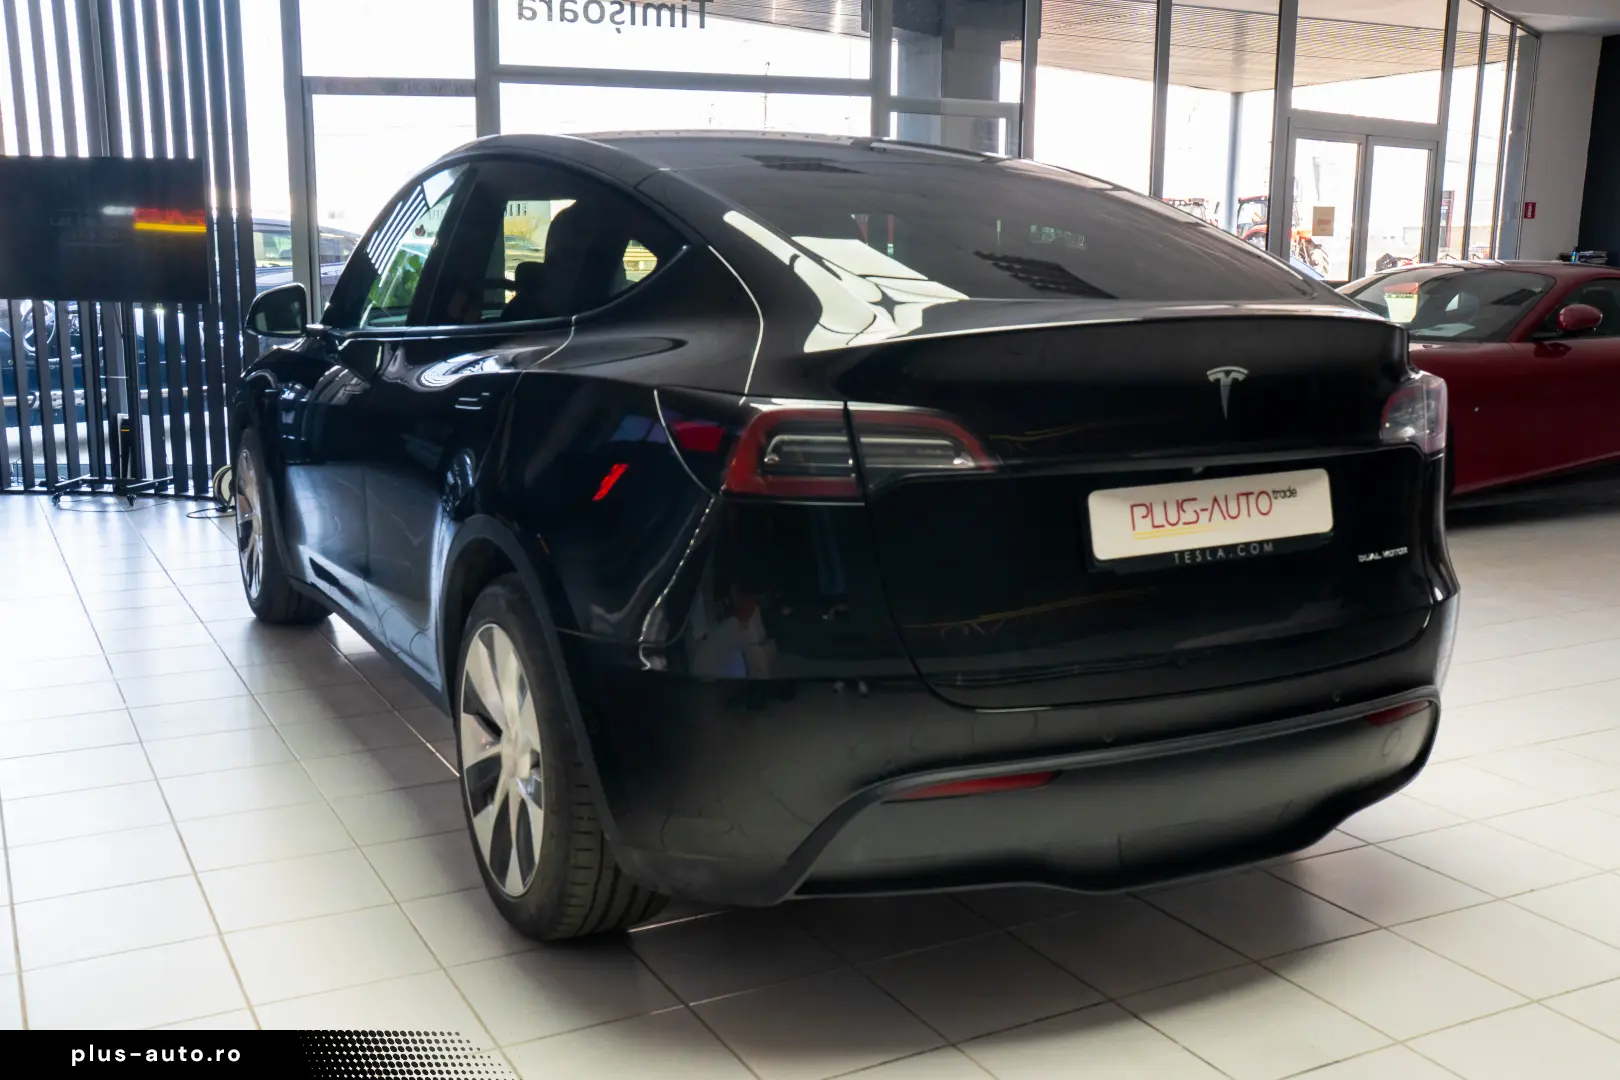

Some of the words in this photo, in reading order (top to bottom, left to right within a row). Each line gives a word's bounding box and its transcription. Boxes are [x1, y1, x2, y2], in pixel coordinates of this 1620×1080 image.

[1130, 490, 1272, 531] PLUS-AUTO
[1271, 486, 1298, 501] trade
[1173, 542, 1275, 565] TESLA.COM
